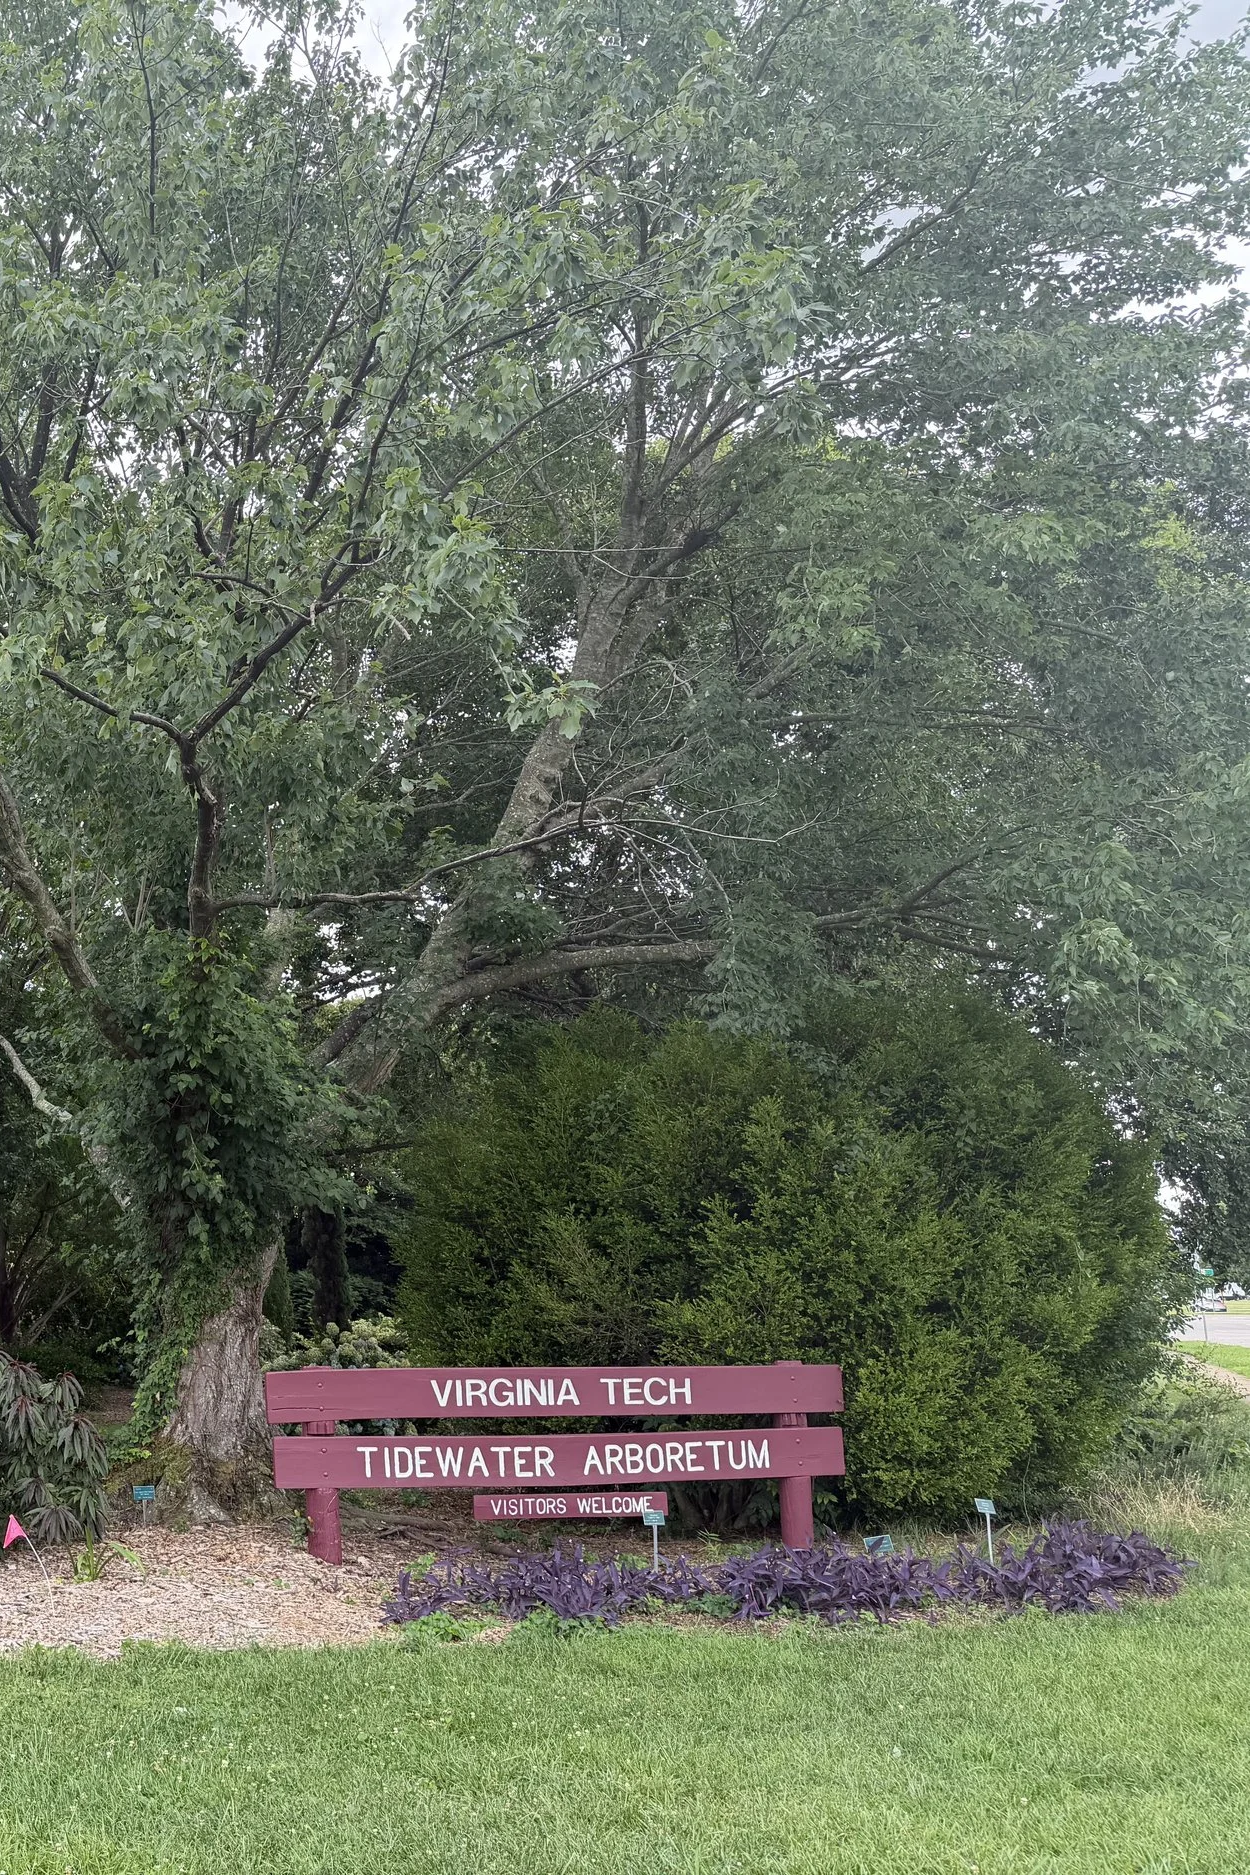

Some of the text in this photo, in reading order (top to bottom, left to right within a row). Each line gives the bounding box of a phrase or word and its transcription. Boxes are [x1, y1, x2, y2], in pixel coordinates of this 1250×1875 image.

[430, 1377, 692, 1407] VIRGINIA TECH
[357, 1439, 769, 1478] TIDEWATER ARBORETUM
[490, 1496, 654, 1515] VISITORS WELCOME
